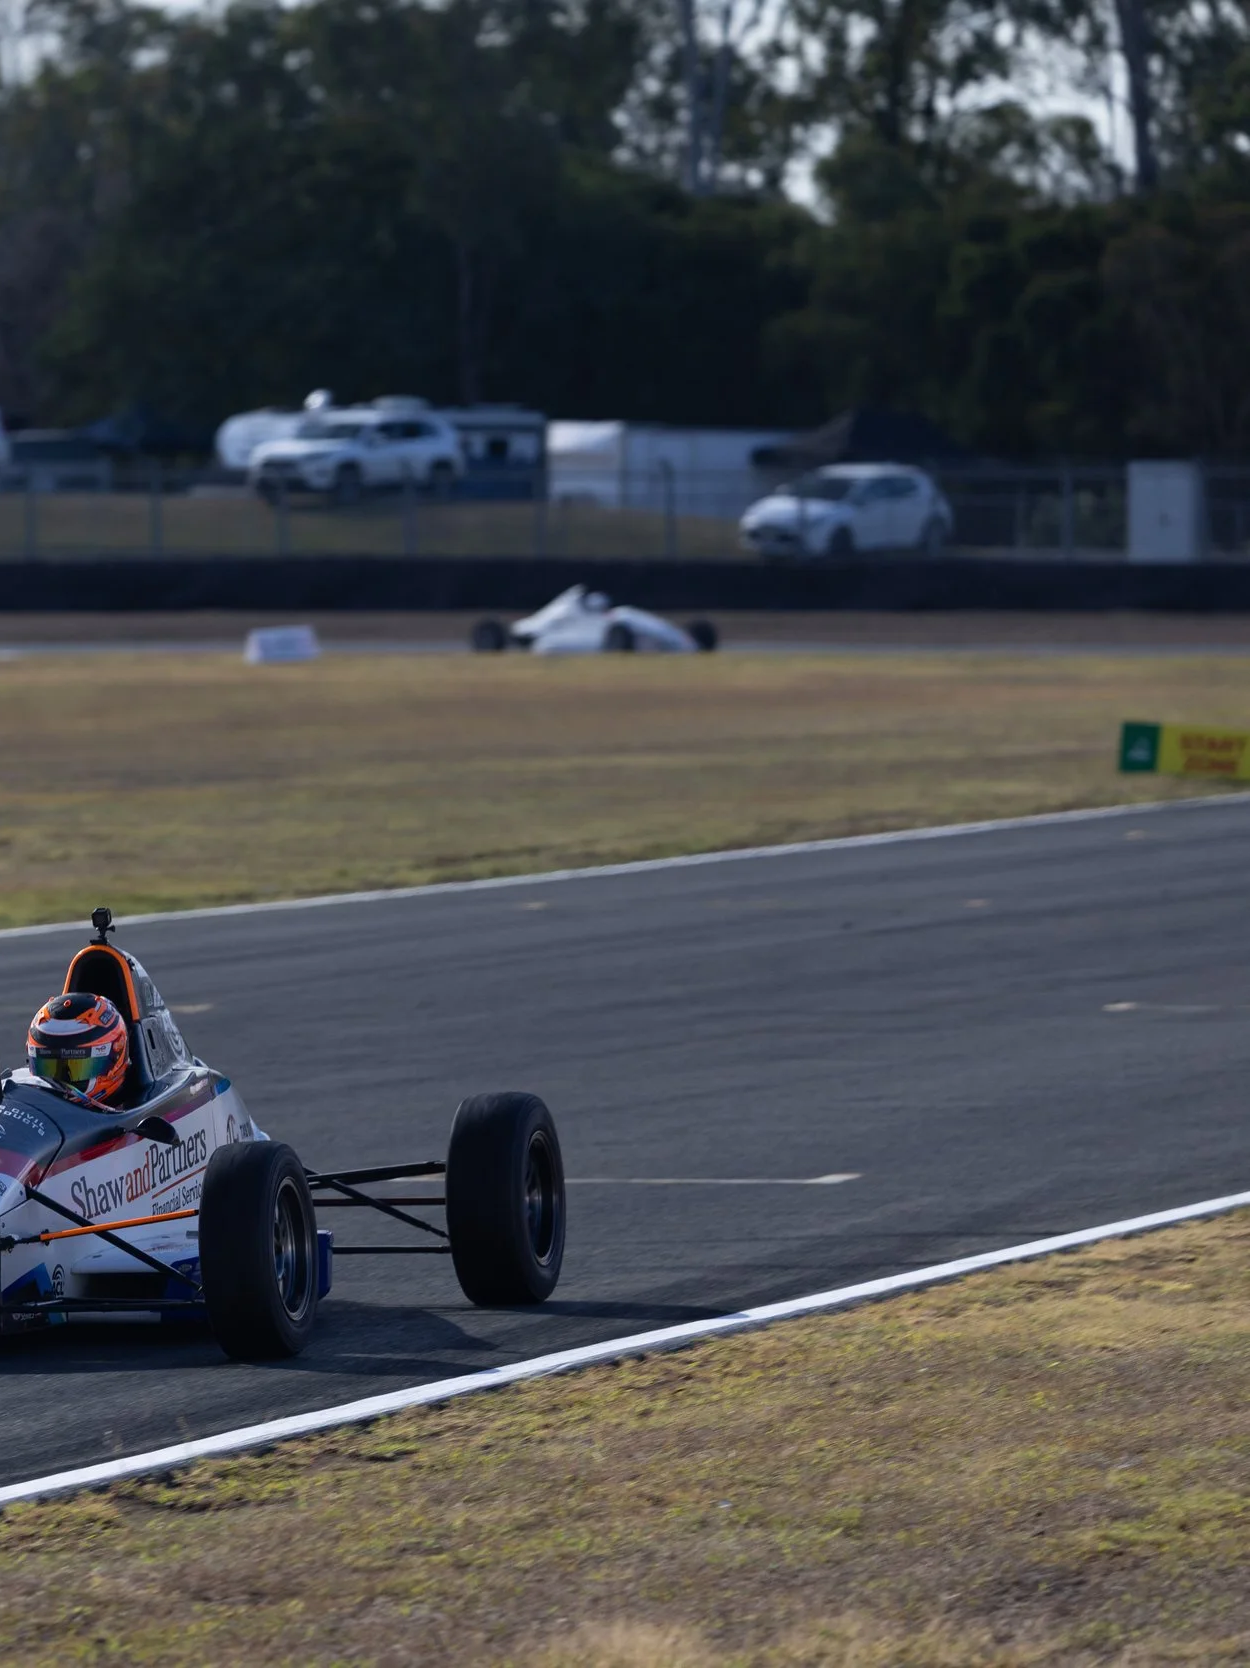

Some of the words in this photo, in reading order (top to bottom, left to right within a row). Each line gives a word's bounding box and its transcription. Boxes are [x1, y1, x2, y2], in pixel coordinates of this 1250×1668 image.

[11, 1107, 47, 1130] CIVIL
[152, 1188, 181, 1215] Financial
[181, 1178, 202, 1210] Servic
